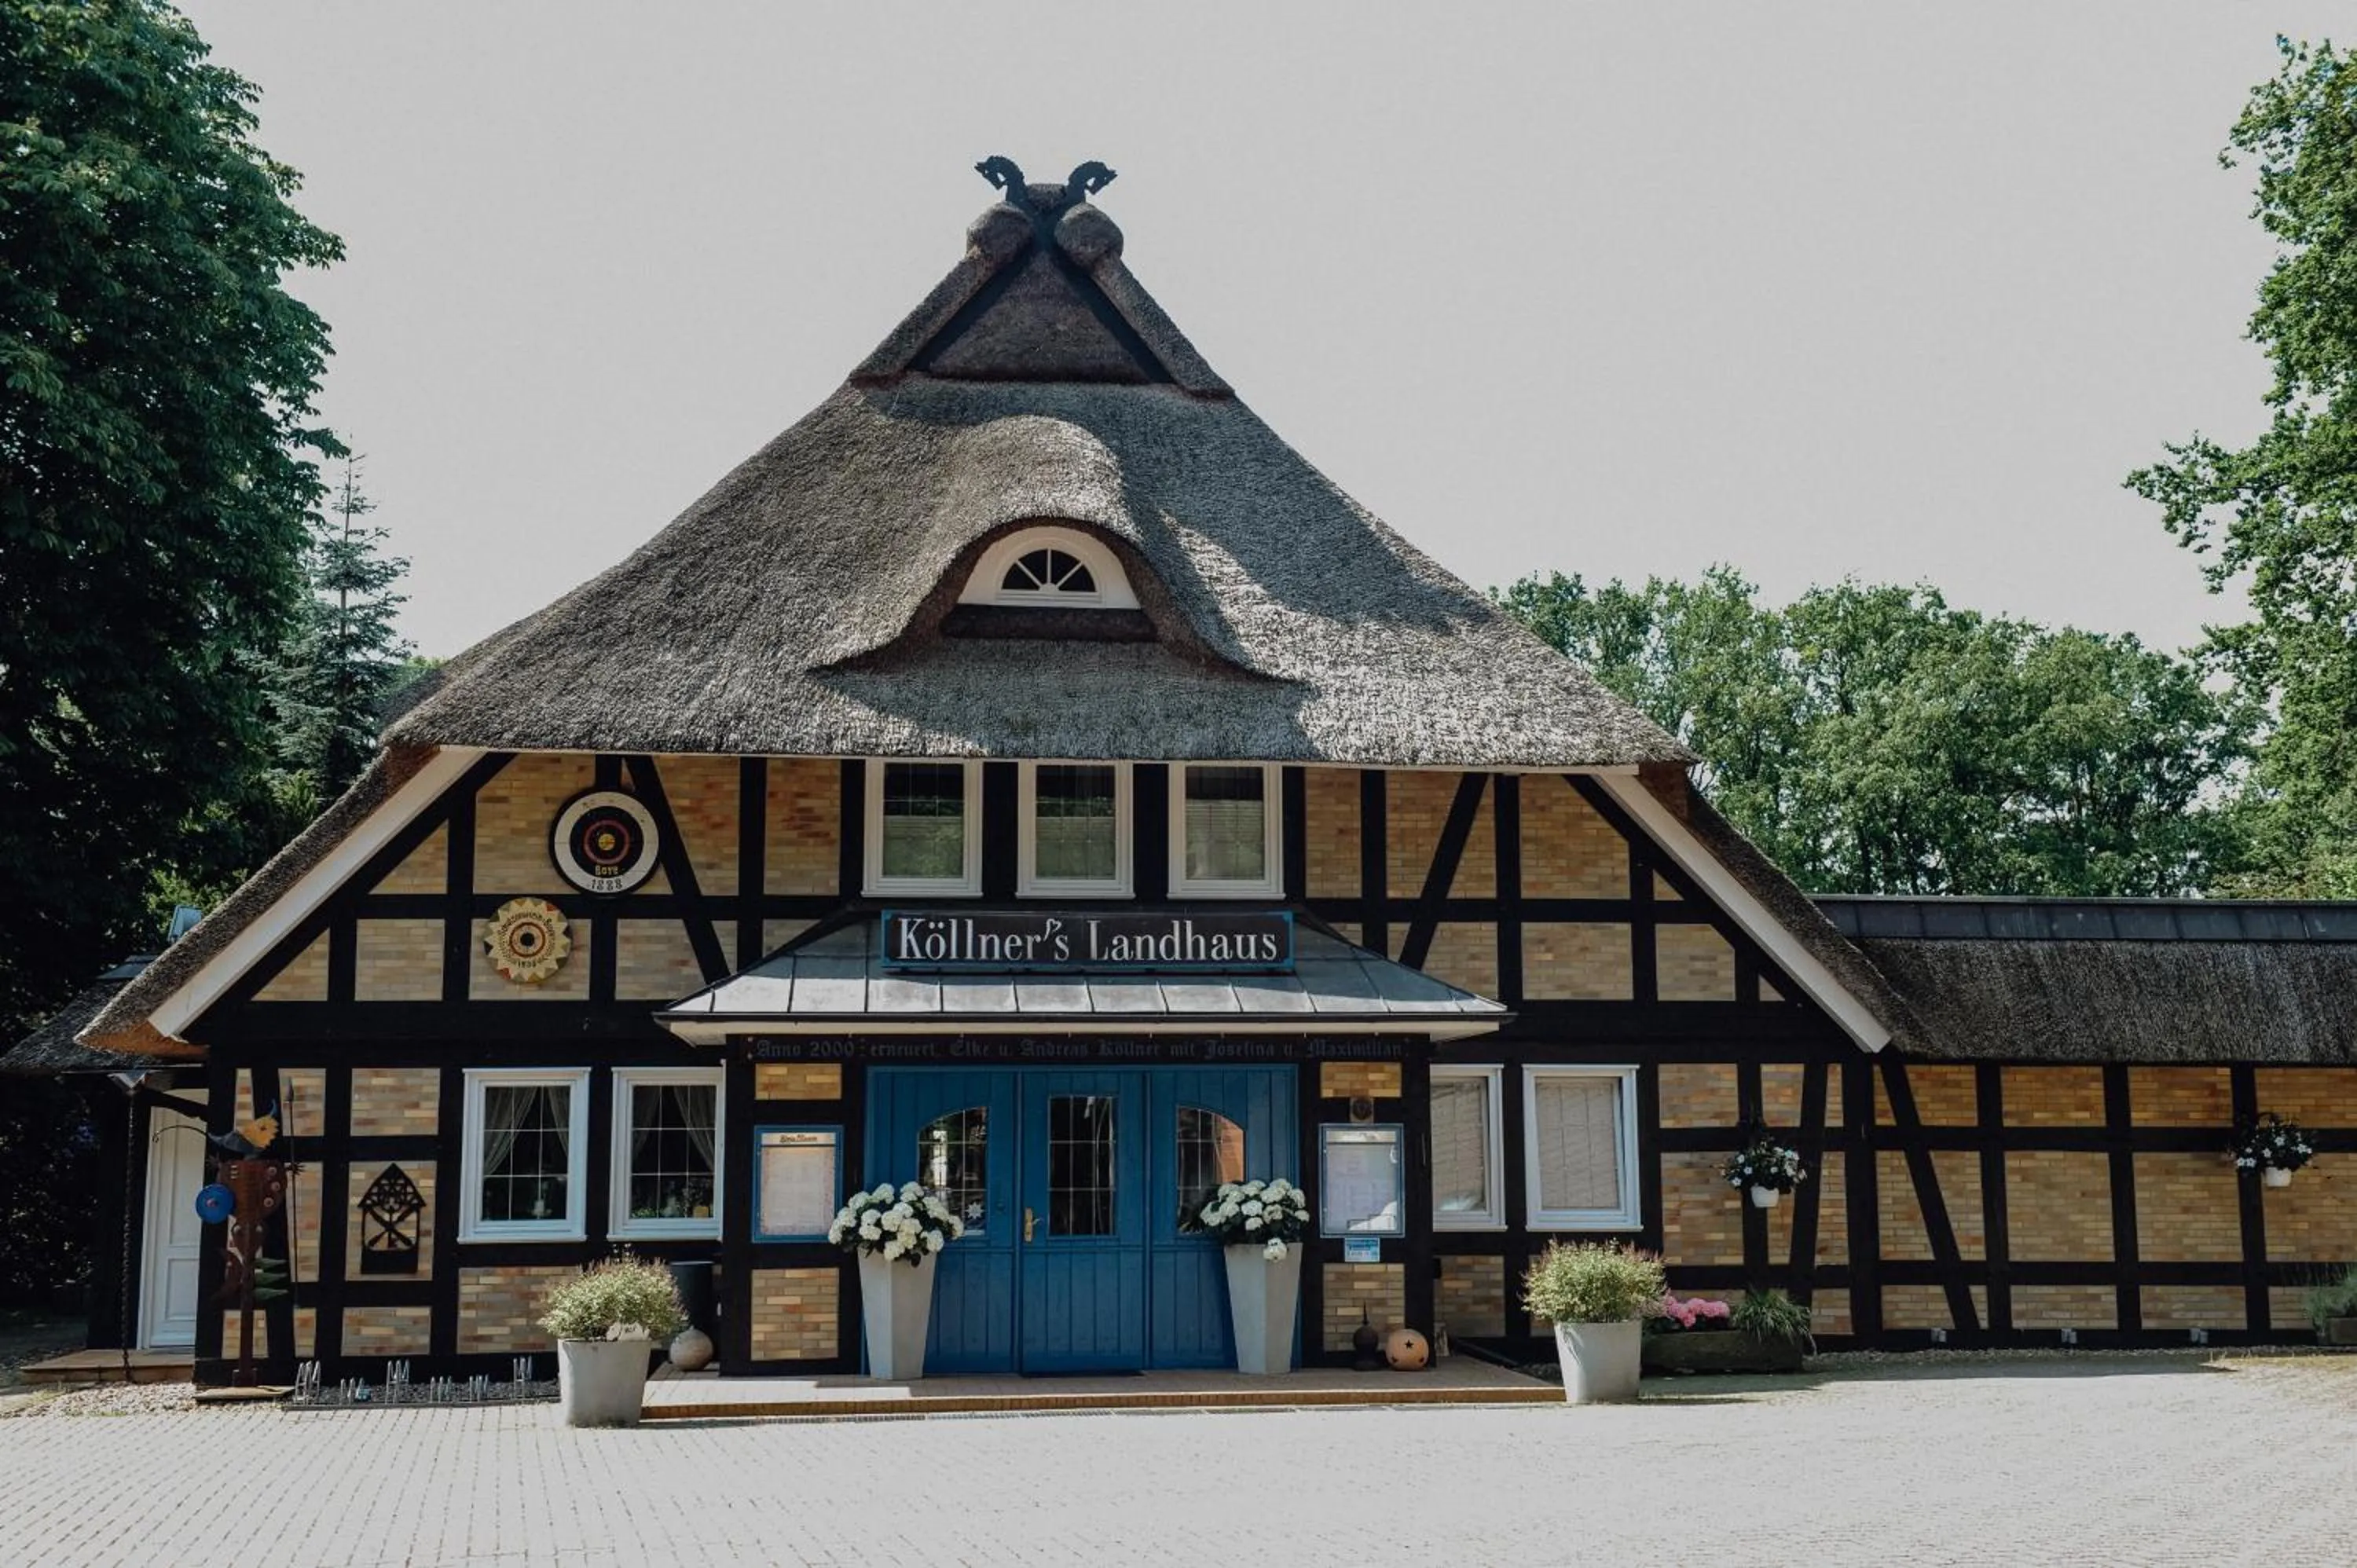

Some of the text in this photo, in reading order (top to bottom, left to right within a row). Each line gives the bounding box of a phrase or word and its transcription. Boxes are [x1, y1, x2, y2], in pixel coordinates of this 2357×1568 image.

[898, 918, 1277, 961] Köllner's Landhaus
[757, 1039, 801, 1057] Anno
[810, 1040, 855, 1057] 2000
[1169, 1040, 1195, 1057] mit
